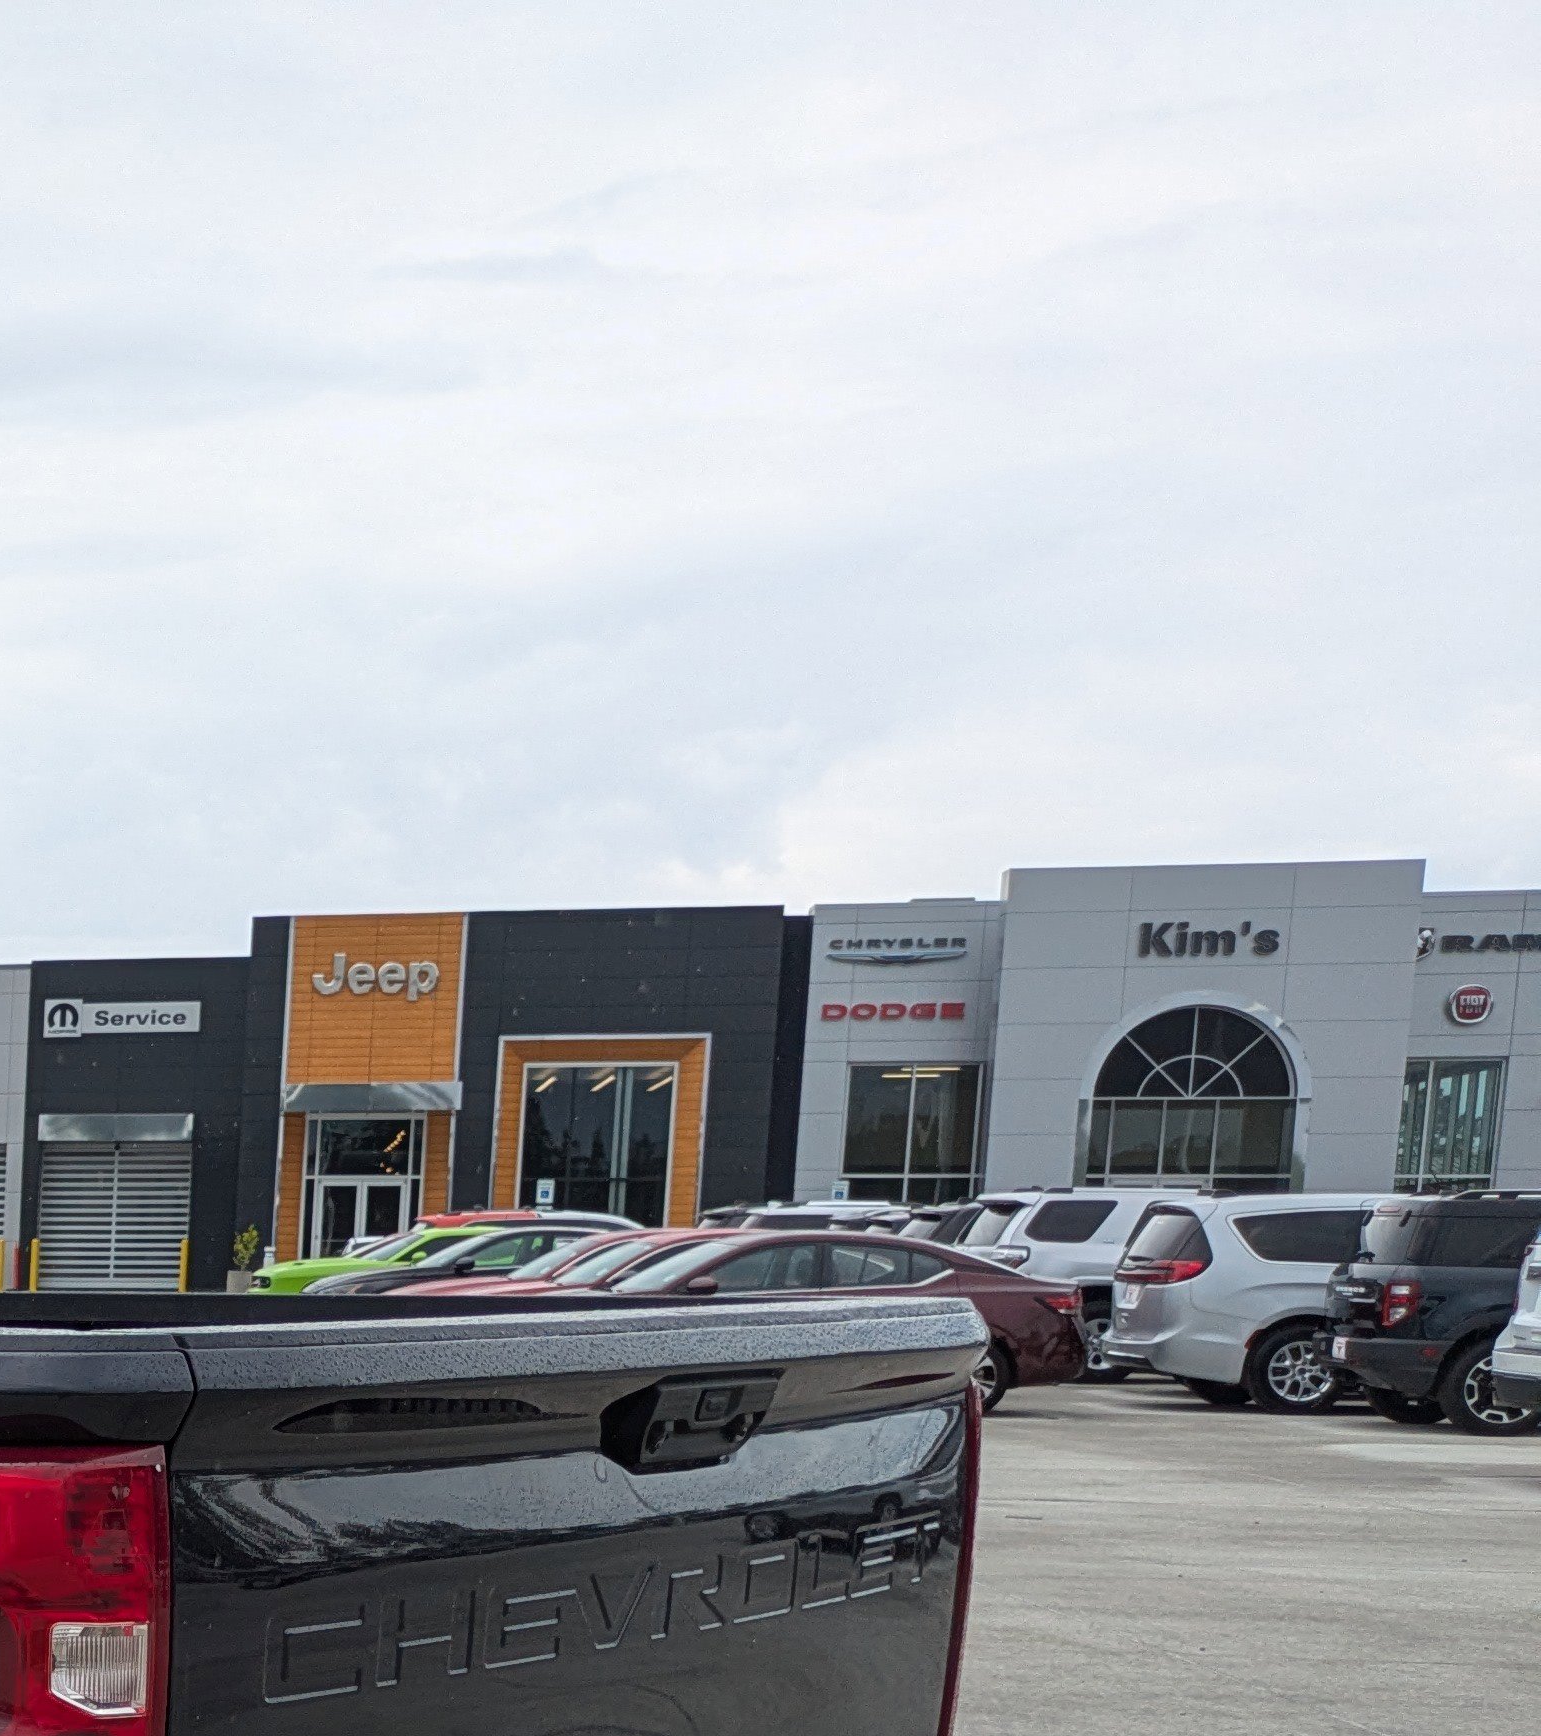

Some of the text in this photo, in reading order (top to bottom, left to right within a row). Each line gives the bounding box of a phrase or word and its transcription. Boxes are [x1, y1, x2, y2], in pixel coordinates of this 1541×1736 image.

[829, 937, 967, 950] CHRYSLER
[1138, 921, 1280, 958] Kim's
[311, 951, 440, 1002] Jeep
[94, 1009, 187, 1027] Service
[820, 1002, 966, 1021] DODGE
[262, 1509, 942, 1704] CHEVROLET
